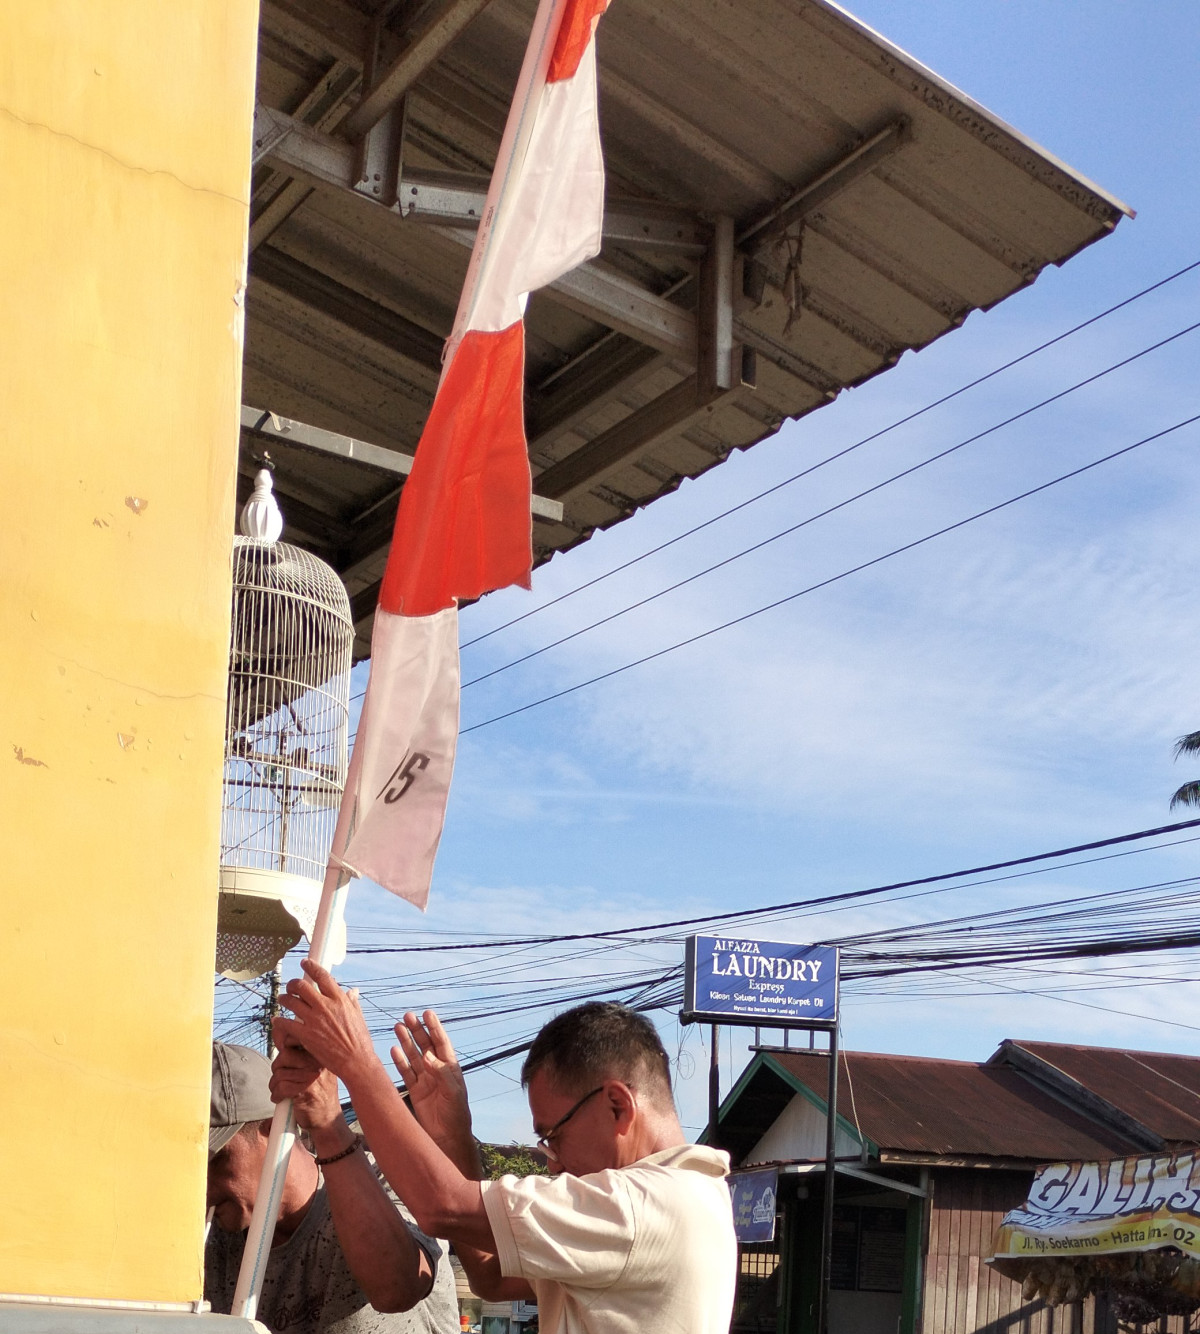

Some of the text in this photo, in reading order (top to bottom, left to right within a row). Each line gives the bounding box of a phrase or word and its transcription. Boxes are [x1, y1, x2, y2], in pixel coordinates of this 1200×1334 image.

[714, 940, 760, 954] ALFAZZA
[711, 952, 822, 982] LAUNDRY
[749, 979, 785, 994] Express
[759, 994, 787, 1005] Laundry
[787, 996, 811, 1007] Karpet
[1021, 1237, 1033, 1250] Jl.
[1034, 1237, 1049, 1253] Ry.
[1050, 1235, 1100, 1250] Soekarno
[1111, 1229, 1145, 1245] Hatta
[1173, 1227, 1196, 1246] 02
